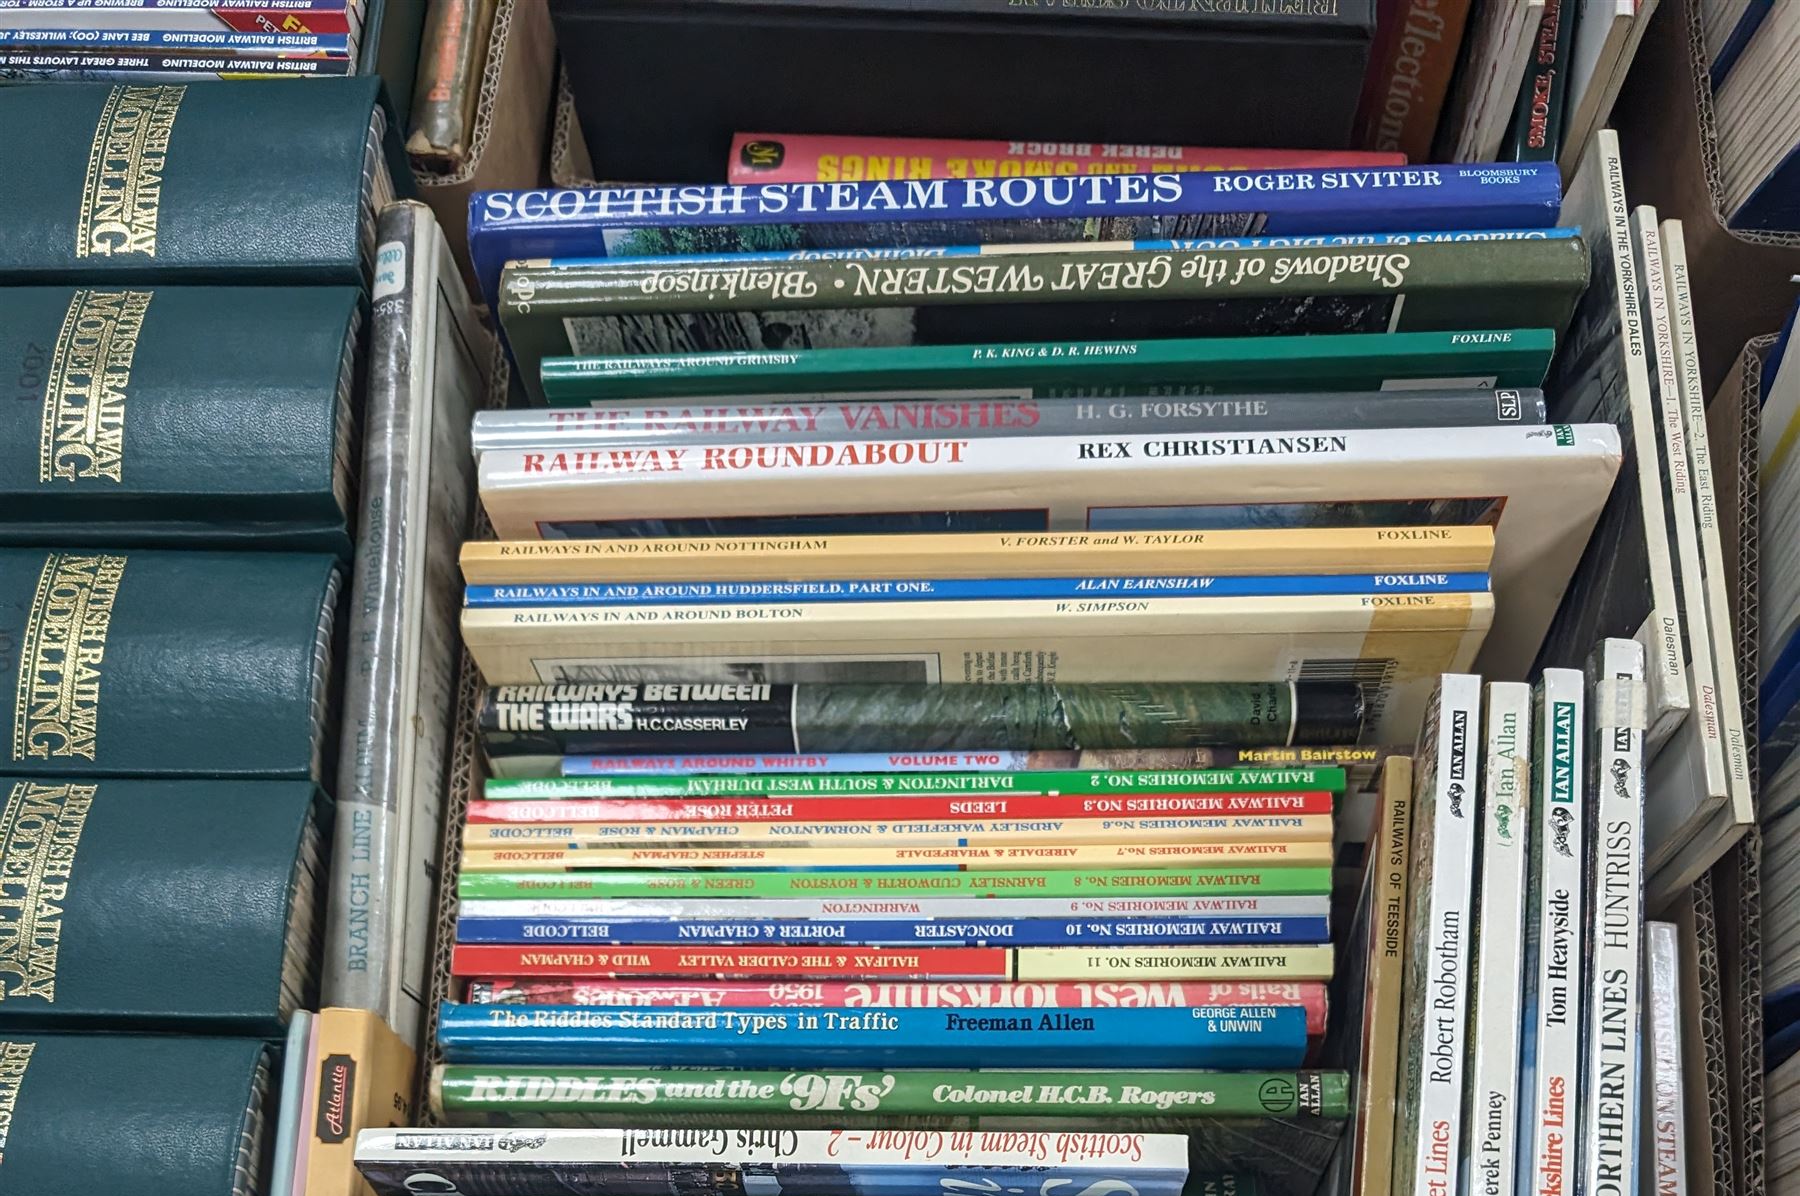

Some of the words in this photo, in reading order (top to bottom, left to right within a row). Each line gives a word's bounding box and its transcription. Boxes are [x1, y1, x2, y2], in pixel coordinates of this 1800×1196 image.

[162, 32, 224, 43] MODELLING
[227, 32, 274, 43] RAILWAY
[277, 33, 317, 44] BRITISH
[34, 56, 79, 65] LAYOUTS
[82, 56, 115, 65] GREAT
[116, 57, 149, 66] THREE
[162, 57, 224, 68] MODELLING
[227, 59, 274, 70] RAILWAY
[277, 60, 317, 71] BRITISH
[143, 85, 188, 156] BRITISH
[90, 85, 164, 257] MODELLING
[1459, 169, 1538, 178] BLOOMSBURY
[1481, 176, 1520, 185] BOOKS
[1608, 157, 1624, 213] RAILWAYS
[484, 184, 746, 222] SCOTTISH
[759, 180, 950, 212] STEAM
[961, 173, 1184, 208] ROUTES
[1214, 173, 1315, 192] ROGER
[1321, 170, 1441, 189] SIVITER
[131, 156, 166, 257] RAILWAY
[1616, 215, 1626, 226] IN
[1617, 230, 1629, 251] THE
[1053, 262, 1172, 291] GREAT
[1180, 260, 1221, 285] the
[1228, 259, 1265, 284] of
[1274, 252, 1410, 287] Shadows
[640, 268, 817, 299] Blenkinsop
[854, 262, 1043, 297] WESTERN
[1620, 253, 1637, 316] YORKSHIRE
[1451, 332, 1512, 344] FOXLINE
[1628, 319, 1642, 356] DALES
[575, 361, 601, 370] THE
[604, 359, 672, 370] RAILWAYS
[678, 357, 733, 368] AROUND
[737, 353, 799, 366] GRIMSBY
[1140, 400, 1268, 418] FORSYTHE
[1500, 393, 1517, 417] SLP
[549, 410, 630, 432] THE
[643, 407, 824, 432] RAILWAY
[839, 401, 1040, 430] VANISHES
[1078, 442, 1132, 459] REX
[1144, 436, 1347, 457] CHRISTIANSEN
[524, 450, 688, 474] RAILWAY
[700, 440, 968, 471] ROUNDABOUT
[1076, 579, 1120, 589] ALAN
[1123, 577, 1215, 589] EARNSHAW
[1373, 574, 1448, 586] FOXLINE
[494, 586, 580, 598] RAILWAYS
[583, 585, 601, 596] IN
[605, 585, 641, 596] AND
[644, 584, 713, 596] AROUND
[849, 583, 892, 594] PART
[1663, 617, 1679, 676] Dalesman
[644, 683, 771, 701] BETWEEN
[499, 703, 545, 730] THE
[548, 702, 633, 731] WARS
[1238, 750, 1297, 762] Martin
[1301, 748, 1376, 761] Bairstow
[688, 779, 763, 792] DURHAM
[767, 779, 814, 791] WEST
[819, 779, 877, 790] SOUTH
[882, 778, 894, 789] &
[898, 775, 1014, 790] DARLINGTON
[1139, 773, 1233, 785] MEMORIES
[1239, 772, 1315, 783] RAILWAY
[950, 800, 1007, 813] LEEDS
[352, 809, 372, 862] LINE
[1603, 821, 1631, 950] HUNTRISS
[822, 903, 920, 913] WARRINGTON
[347, 872, 369, 973] BRANCH
[764, 925, 775, 937] &
[914, 924, 1014, 937] DONCASTER
[523, 925, 609, 938] BELLCODE
[679, 925, 759, 938] CHAPMAN
[780, 925, 846, 938] PORTER
[1434, 910, 1459, 1010] Robotham
[1192, 1007, 1235, 1018] GEORGE
[1239, 1007, 1276, 1018] ALLEN
[1602, 968, 1627, 1053] LINES
[491, 1010, 532, 1029] The
[536, 1010, 614, 1030] Riddles
[619, 1011, 717, 1030] Standard
[723, 1012, 787, 1035] Types
[798, 1012, 819, 1031] in
[823, 1012, 898, 1031] Traffic
[946, 1014, 1036, 1031] Freeman
[1041, 1014, 1095, 1031] Allen
[1207, 1020, 1217, 1032] &
[1220, 1019, 1261, 1032] UNWIN
[1431, 1014, 1453, 1084] Robert
[472, 1074, 662, 1104] RIDDLES
[666, 1080, 723, 1099] and
[727, 1080, 773, 1099] the
[933, 1084, 1033, 1104] Colonel
[1039, 1086, 1111, 1104] H.C.B.
[1122, 1086, 1215, 1109] Rogers
[325, 1065, 345, 1135] Atlantic
[1425, 1120, 1450, 1174] Lines
